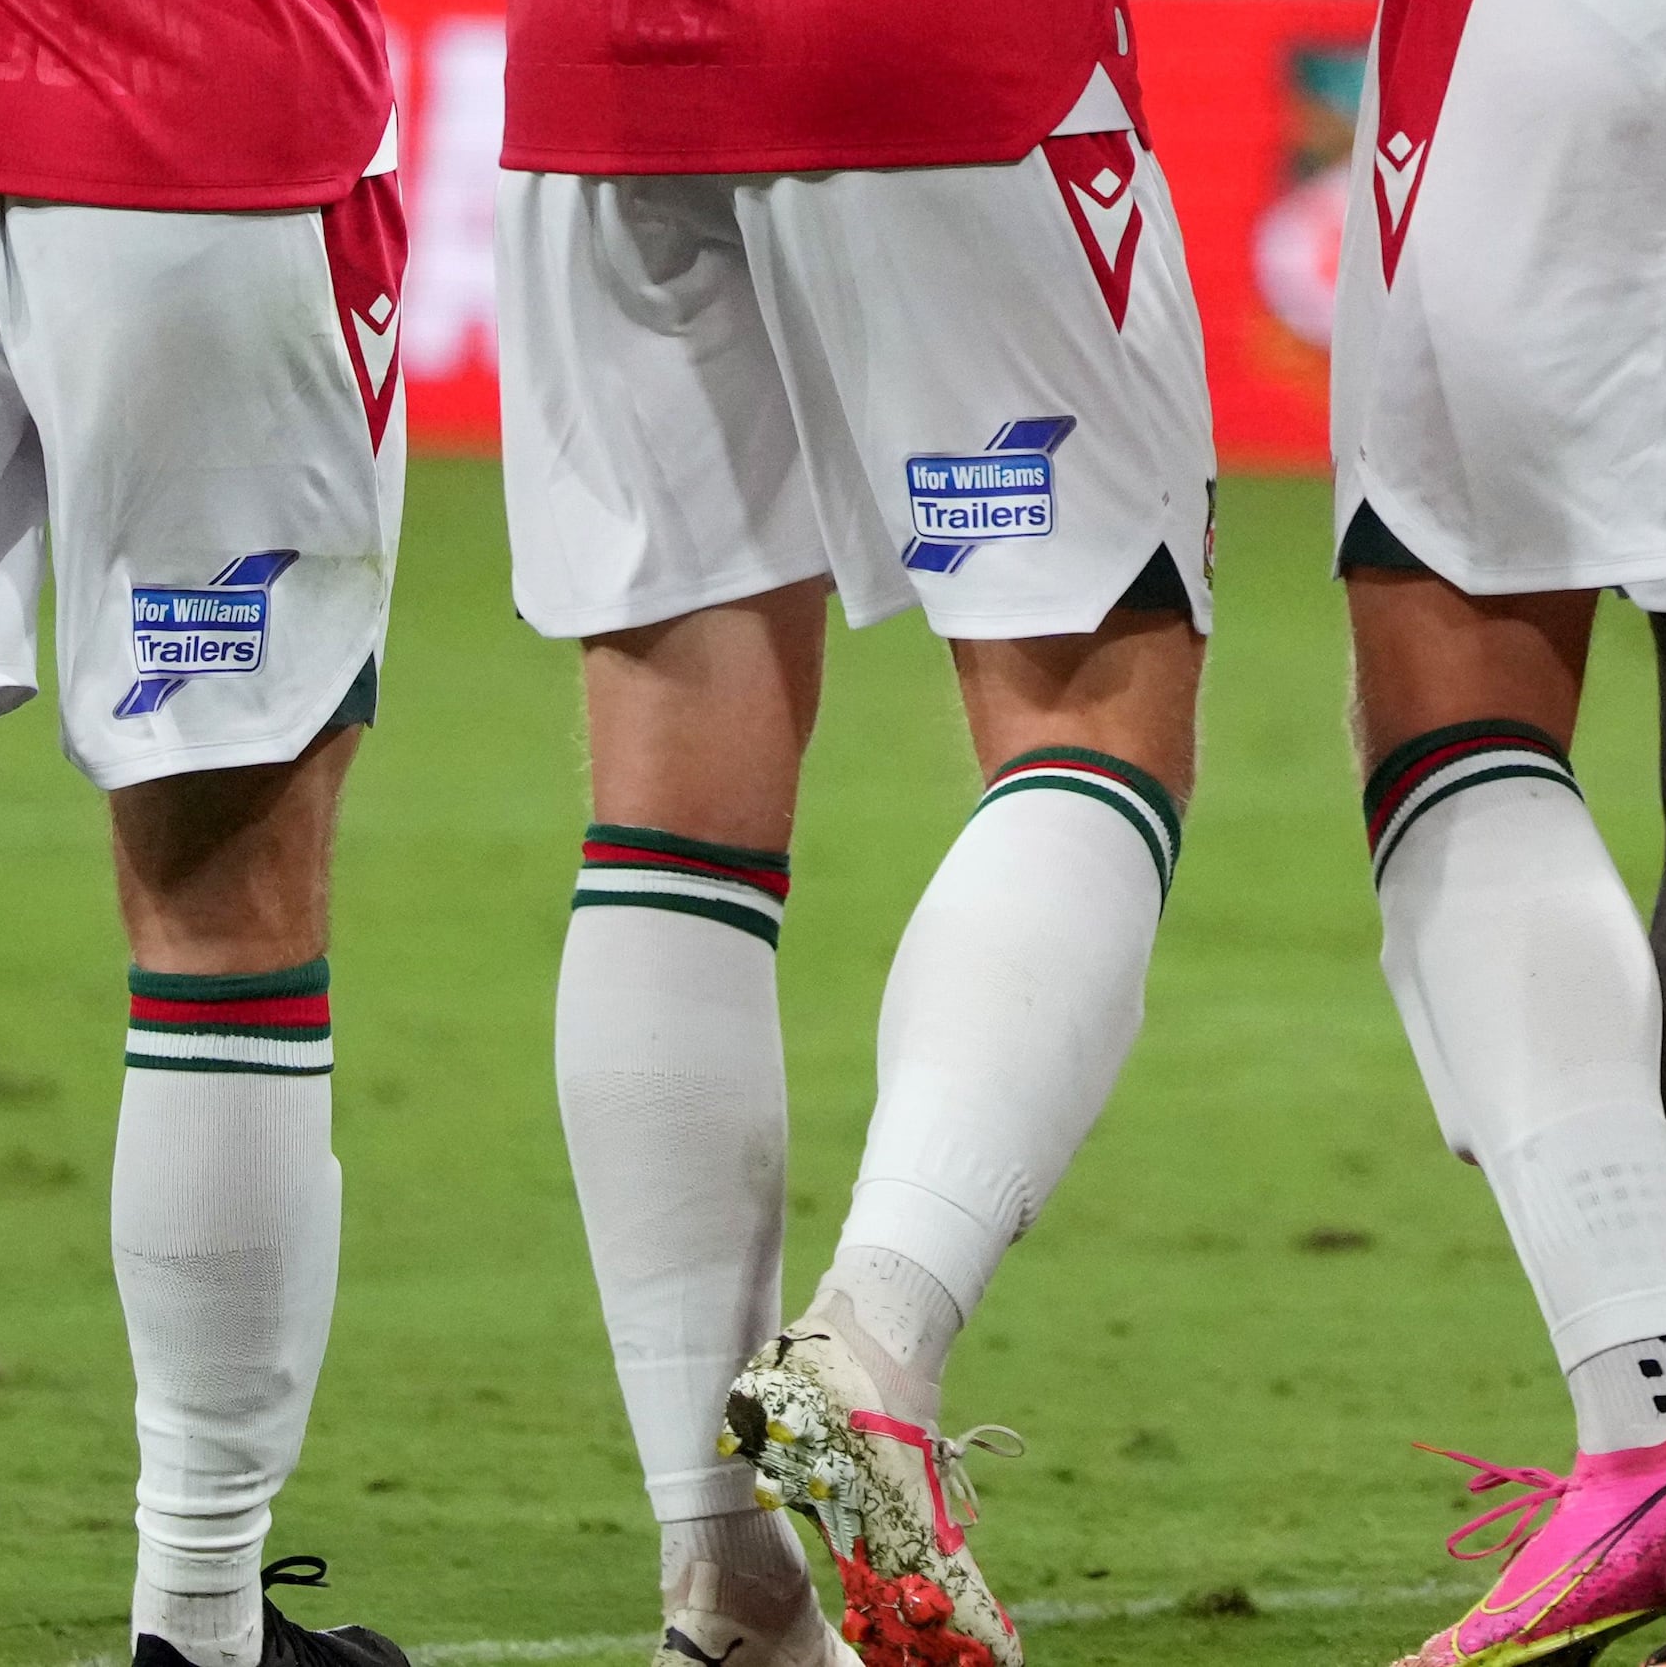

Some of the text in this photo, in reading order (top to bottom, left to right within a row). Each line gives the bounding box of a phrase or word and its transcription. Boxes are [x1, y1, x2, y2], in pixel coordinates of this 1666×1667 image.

[912, 465, 1045, 490] Ifor Williams
[917, 501, 1046, 529] Trailers
[134, 597, 260, 623] Ifor Williams
[137, 635, 255, 663] Trailers
